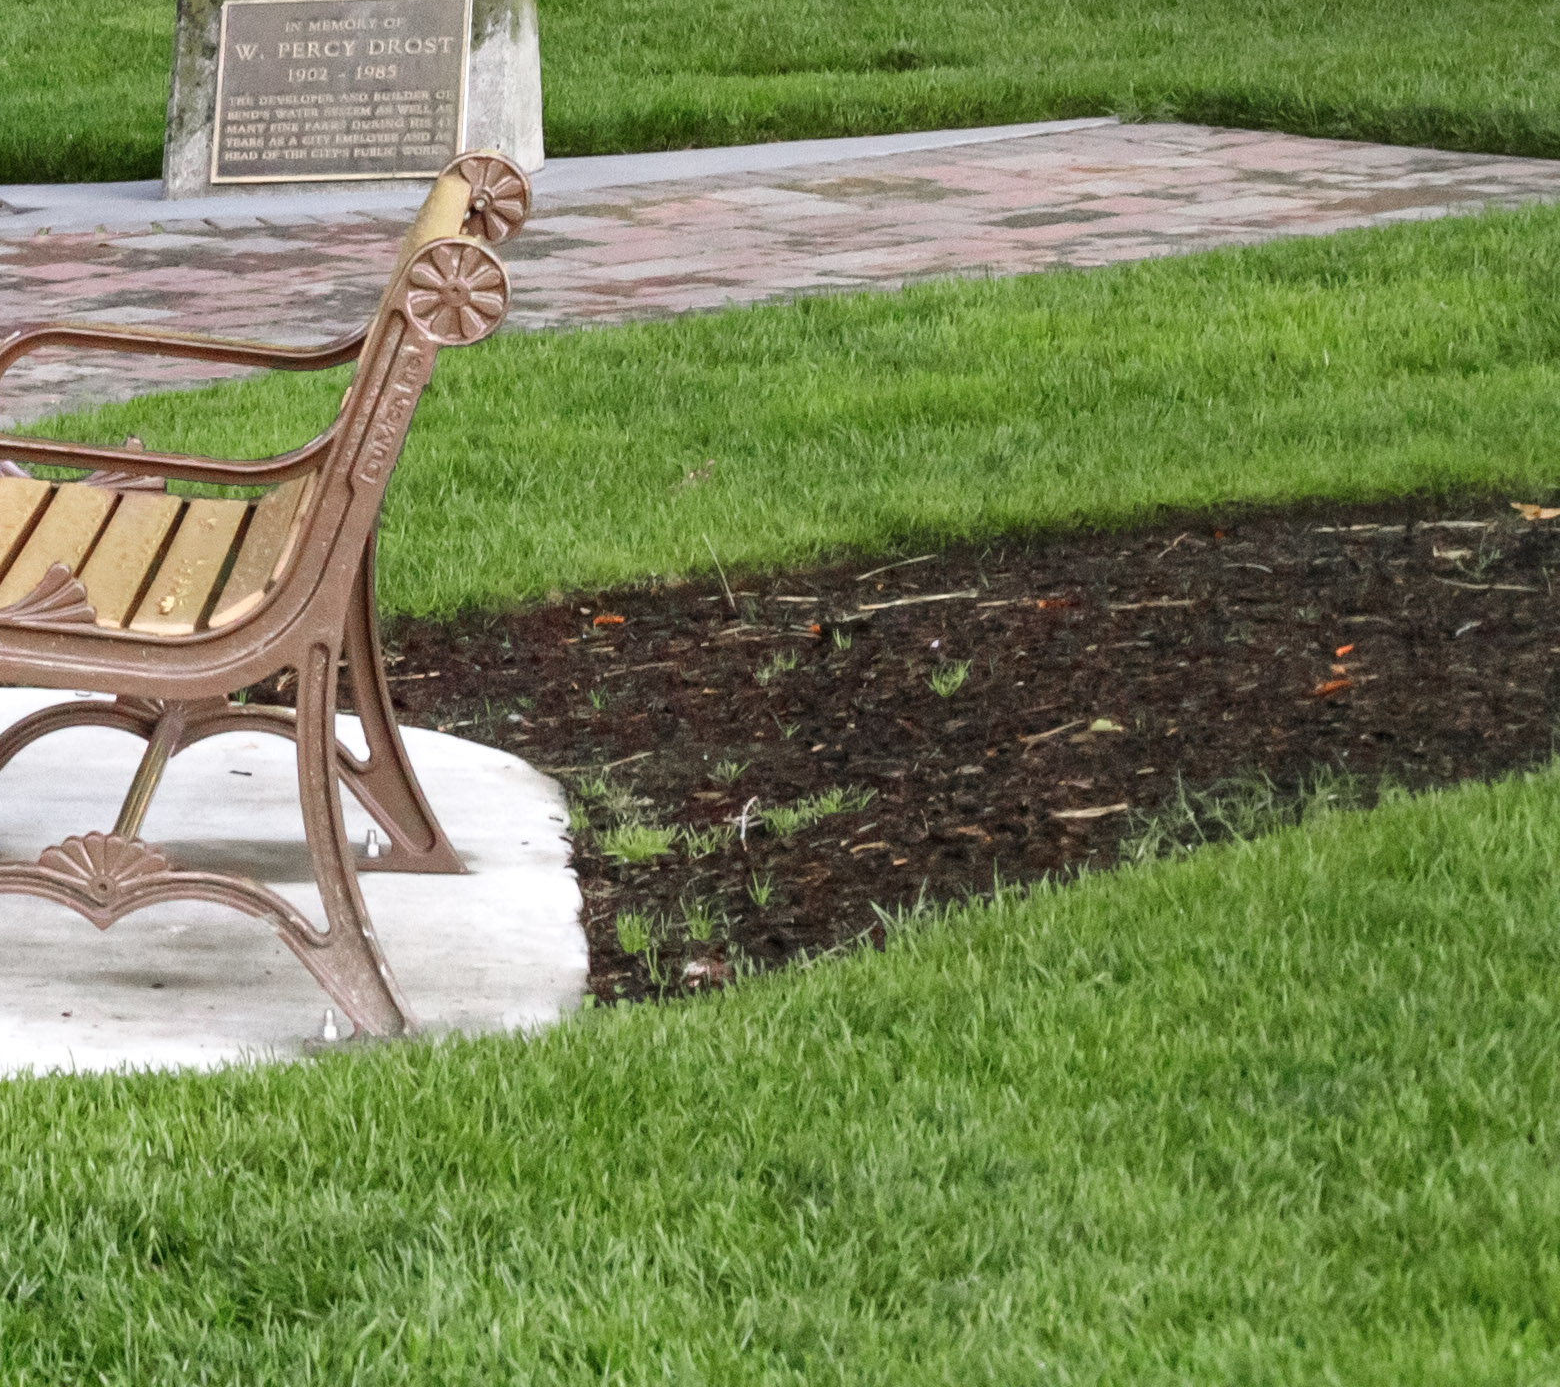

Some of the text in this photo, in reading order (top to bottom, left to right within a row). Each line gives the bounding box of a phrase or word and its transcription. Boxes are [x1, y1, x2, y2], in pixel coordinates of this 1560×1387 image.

[285, 16, 406, 33] IN MEMORY OF
[235, 36, 454, 61] W. PERCY DROST
[287, 66, 329, 83] 1902
[228, 89, 455, 107] THE DEVELOPER AND BUILDER OF
[275, 107, 318, 119] WATER
[397, 104, 432, 115] WELL
[225, 123, 266, 134] MANY
[270, 122, 299, 133] FINE
[352, 118, 405, 130] DURING
[225, 137, 264, 148] YEARS
[288, 136, 298, 146] A
[301, 134, 331, 146] CITY
[335, 133, 399, 144] EMPLOYEE
[403, 131, 431, 142] AND
[224, 150, 258, 161] HEAD
[262, 149, 280, 160] OF
[284, 149, 307, 160] THE
[353, 146, 396, 157] PUBLIC
